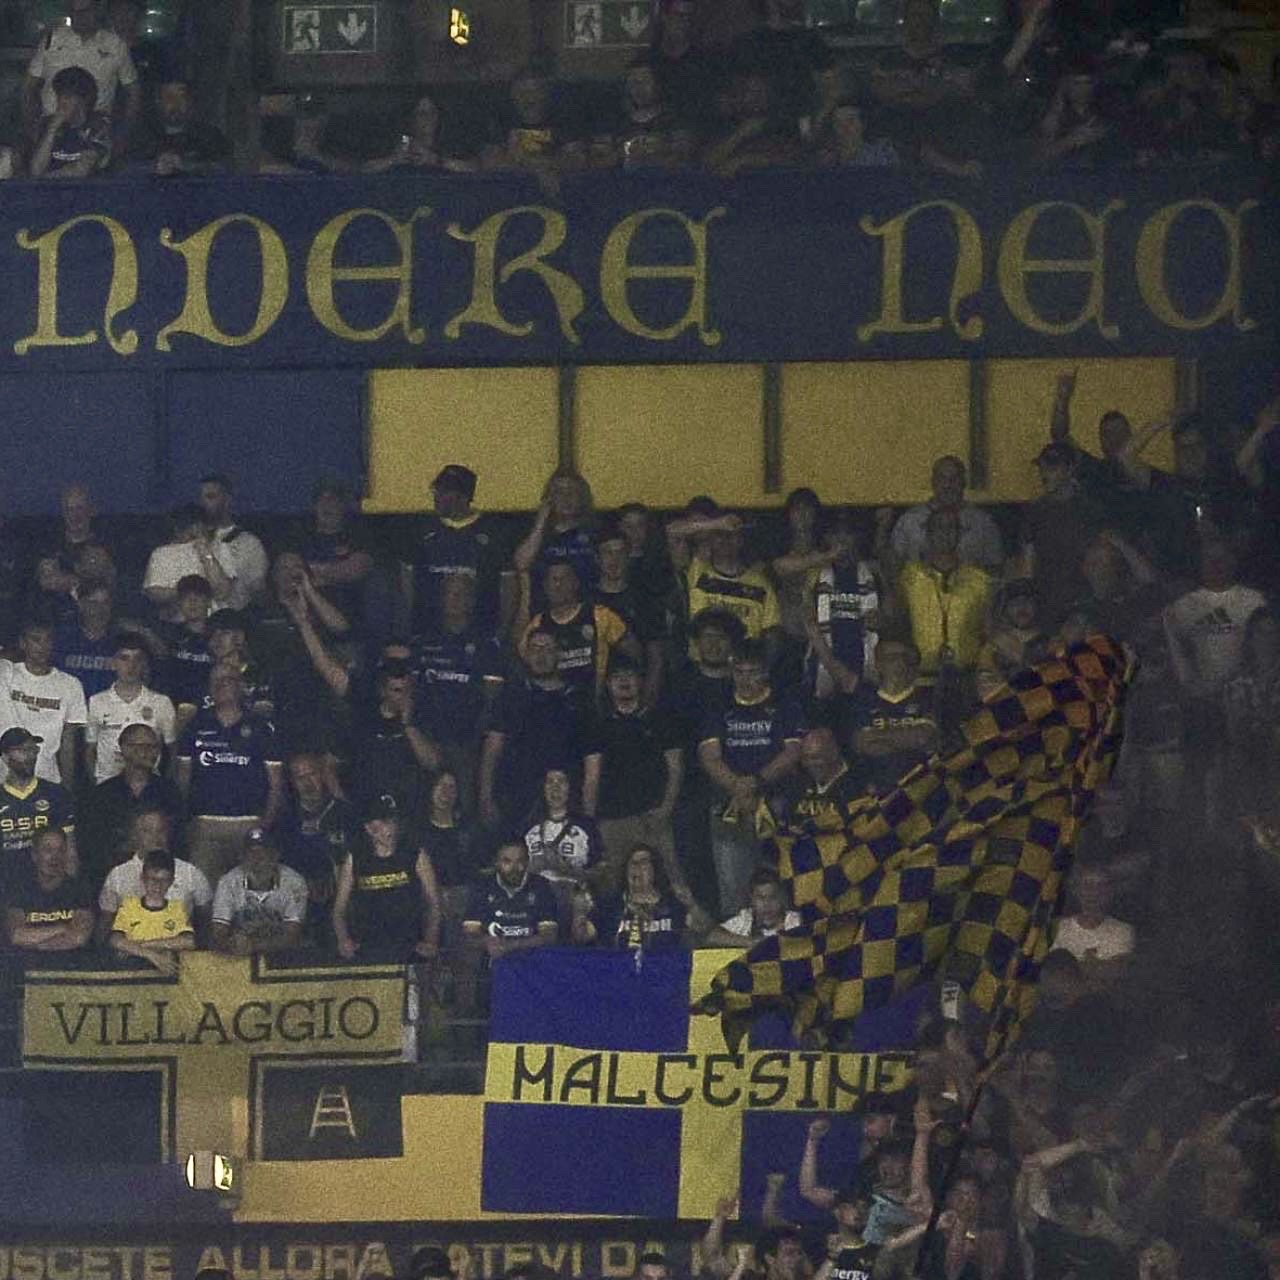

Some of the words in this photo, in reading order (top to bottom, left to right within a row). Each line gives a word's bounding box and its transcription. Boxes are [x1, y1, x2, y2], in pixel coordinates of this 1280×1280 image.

[857, 198, 1260, 342] NEC
[51, 997, 381, 1045] VILLAGGIO
[511, 1046, 916, 1107] MALCESINE
